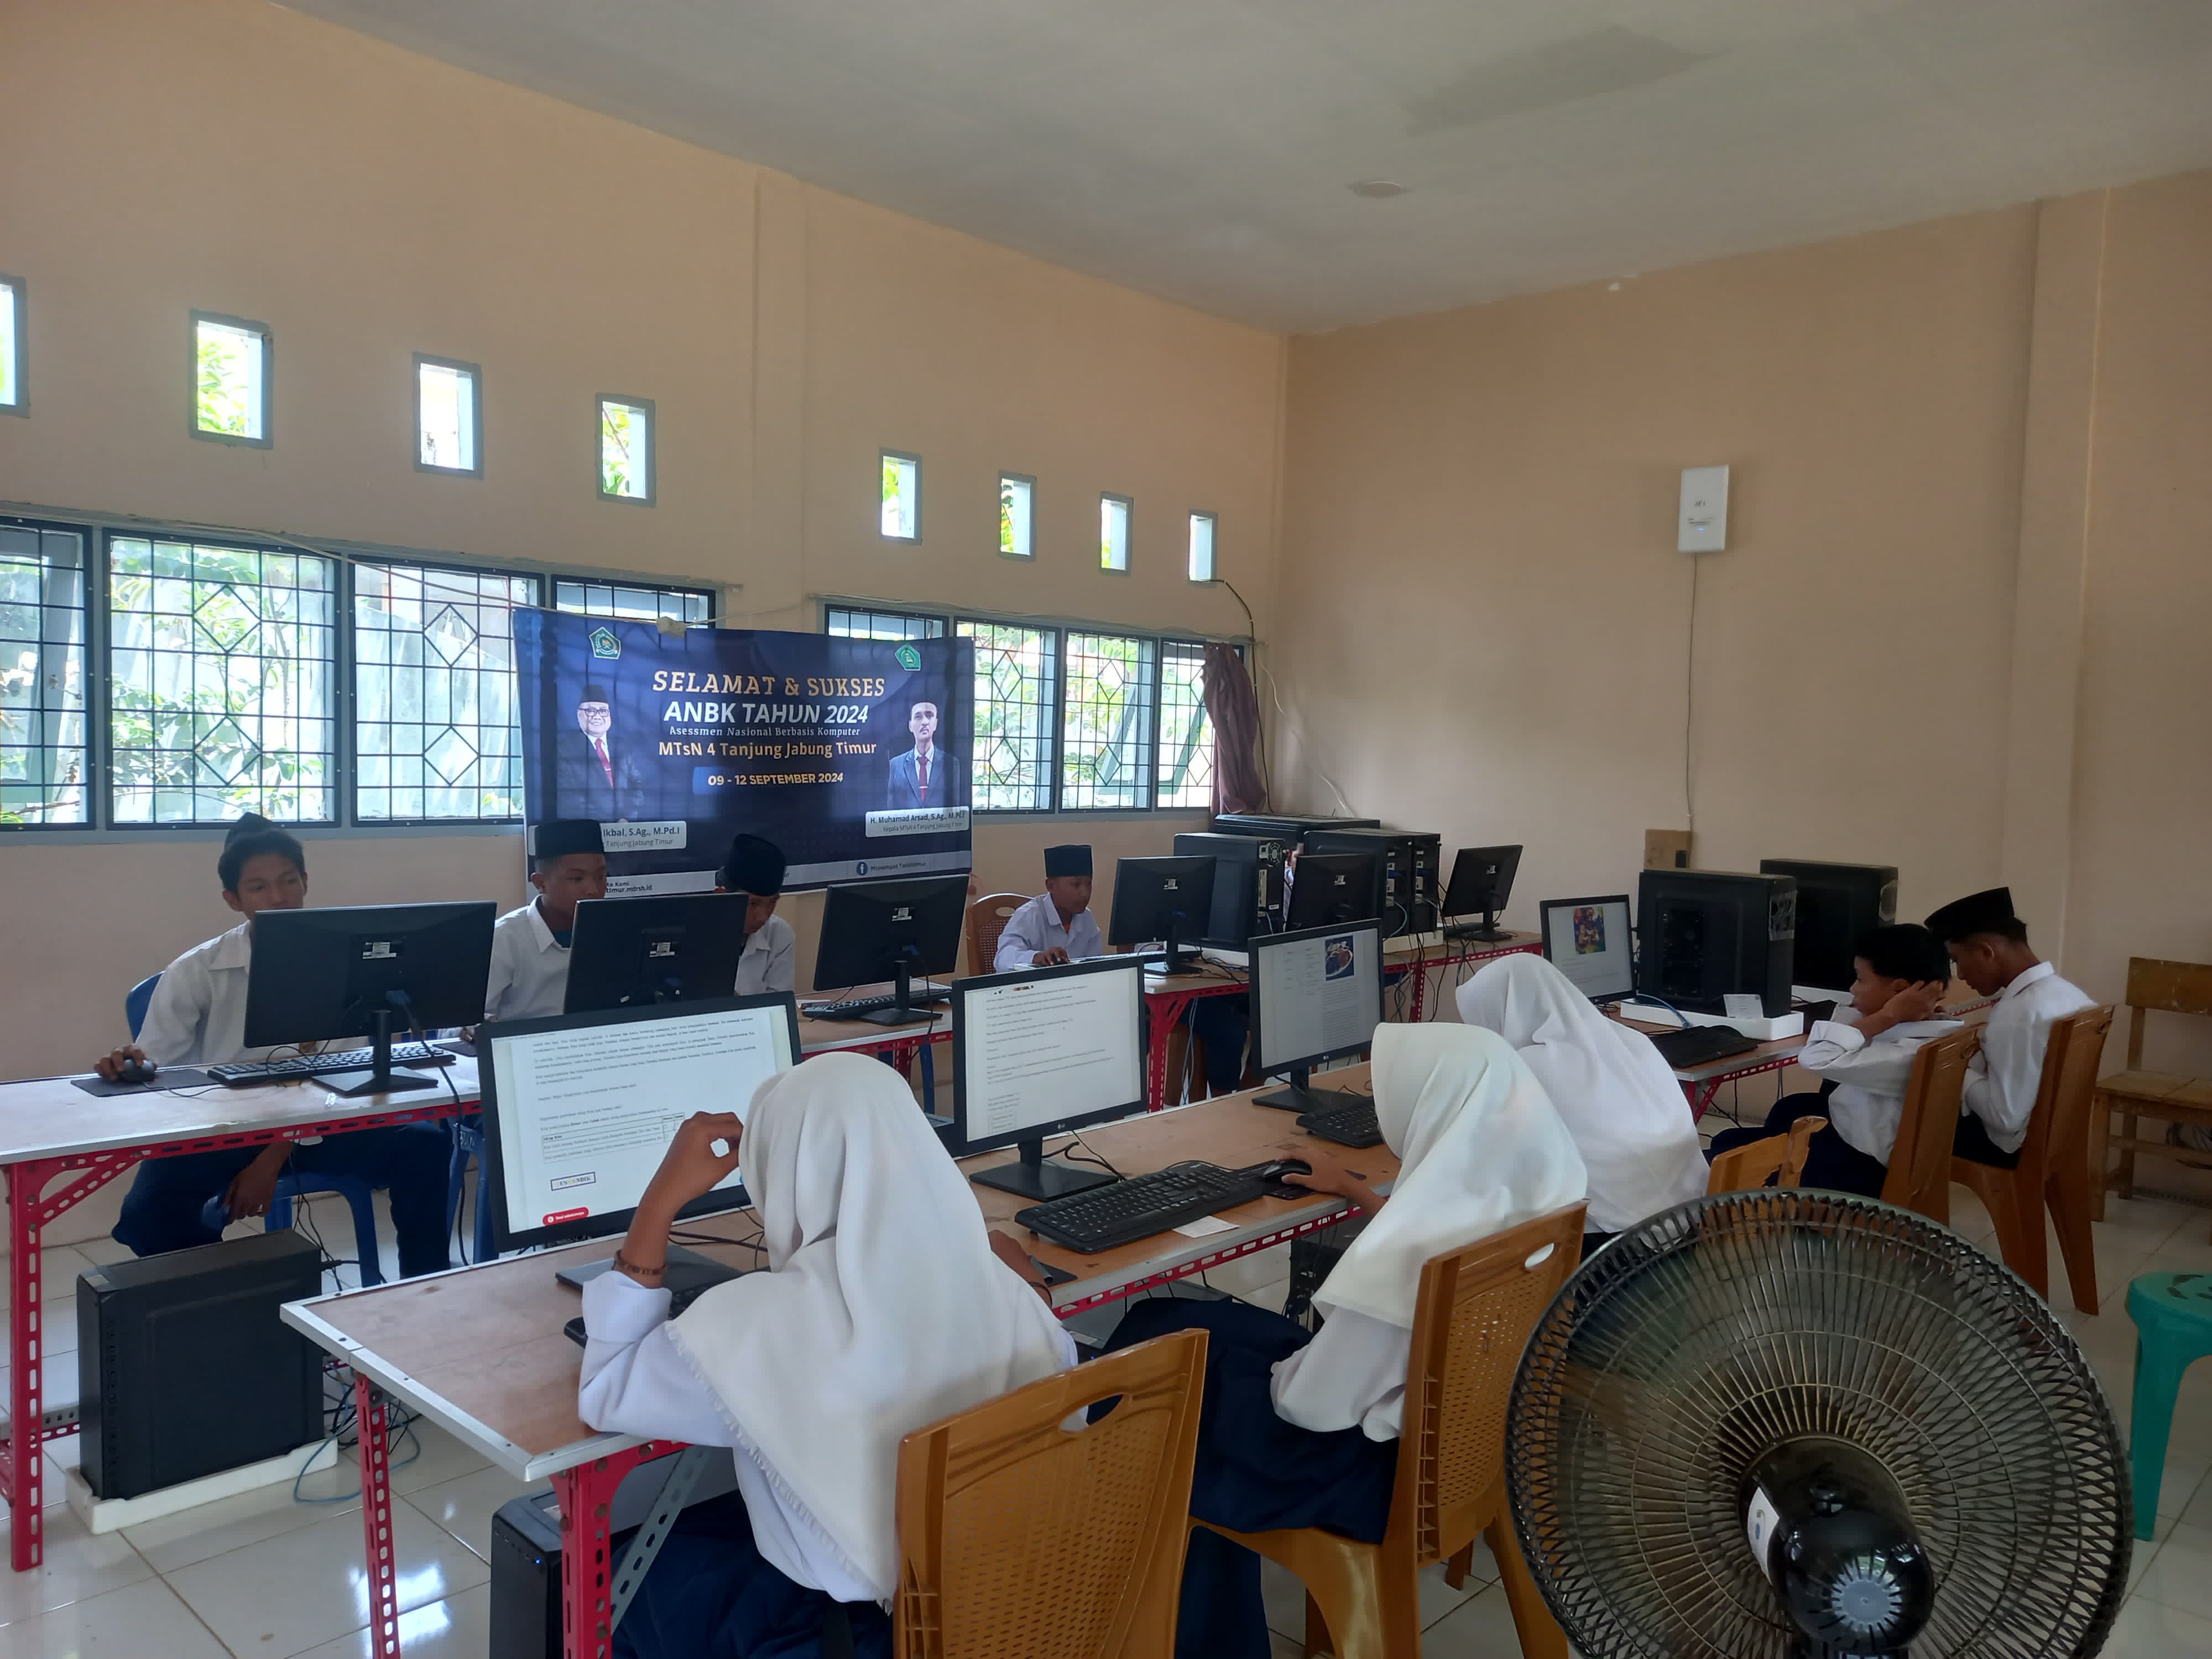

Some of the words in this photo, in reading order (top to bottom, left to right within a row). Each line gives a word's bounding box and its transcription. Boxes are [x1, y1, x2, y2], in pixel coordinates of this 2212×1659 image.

[652, 670, 775, 695] SELAMAT
[785, 677, 799, 696] &
[807, 677, 885, 697] SUKSES
[663, 701, 736, 723] ANBK
[742, 703, 820, 724] TAHUN
[824, 705, 869, 724] 2024
[669, 726, 723, 736] Asessmen
[726, 727, 773, 737] Nasional
[775, 727, 815, 737] Berbasis
[818, 727, 860, 738] Komputer
[659, 742, 703, 756] MTsN
[707, 742, 716, 756] 4
[719, 742, 782, 760] Tanjung
[785, 742, 832, 759] Jabung
[836, 742, 877, 755] Timur
[708, 775, 724, 786] 09
[734, 775, 747, 785] 12
[749, 773, 816, 785] SEPTEMBER
[818, 772, 844, 783] 2024
[878, 815, 909, 823] Muhamad
[911, 813, 930, 822] Arsad,
[603, 827, 627, 837] Ikbal,
[629, 827, 651, 838] S.Ag.,
[654, 826, 680, 835] M.Pd.I
[606, 840, 632, 848] Tanjung
[606, 884, 653, 894] timur.mdrsh.id
